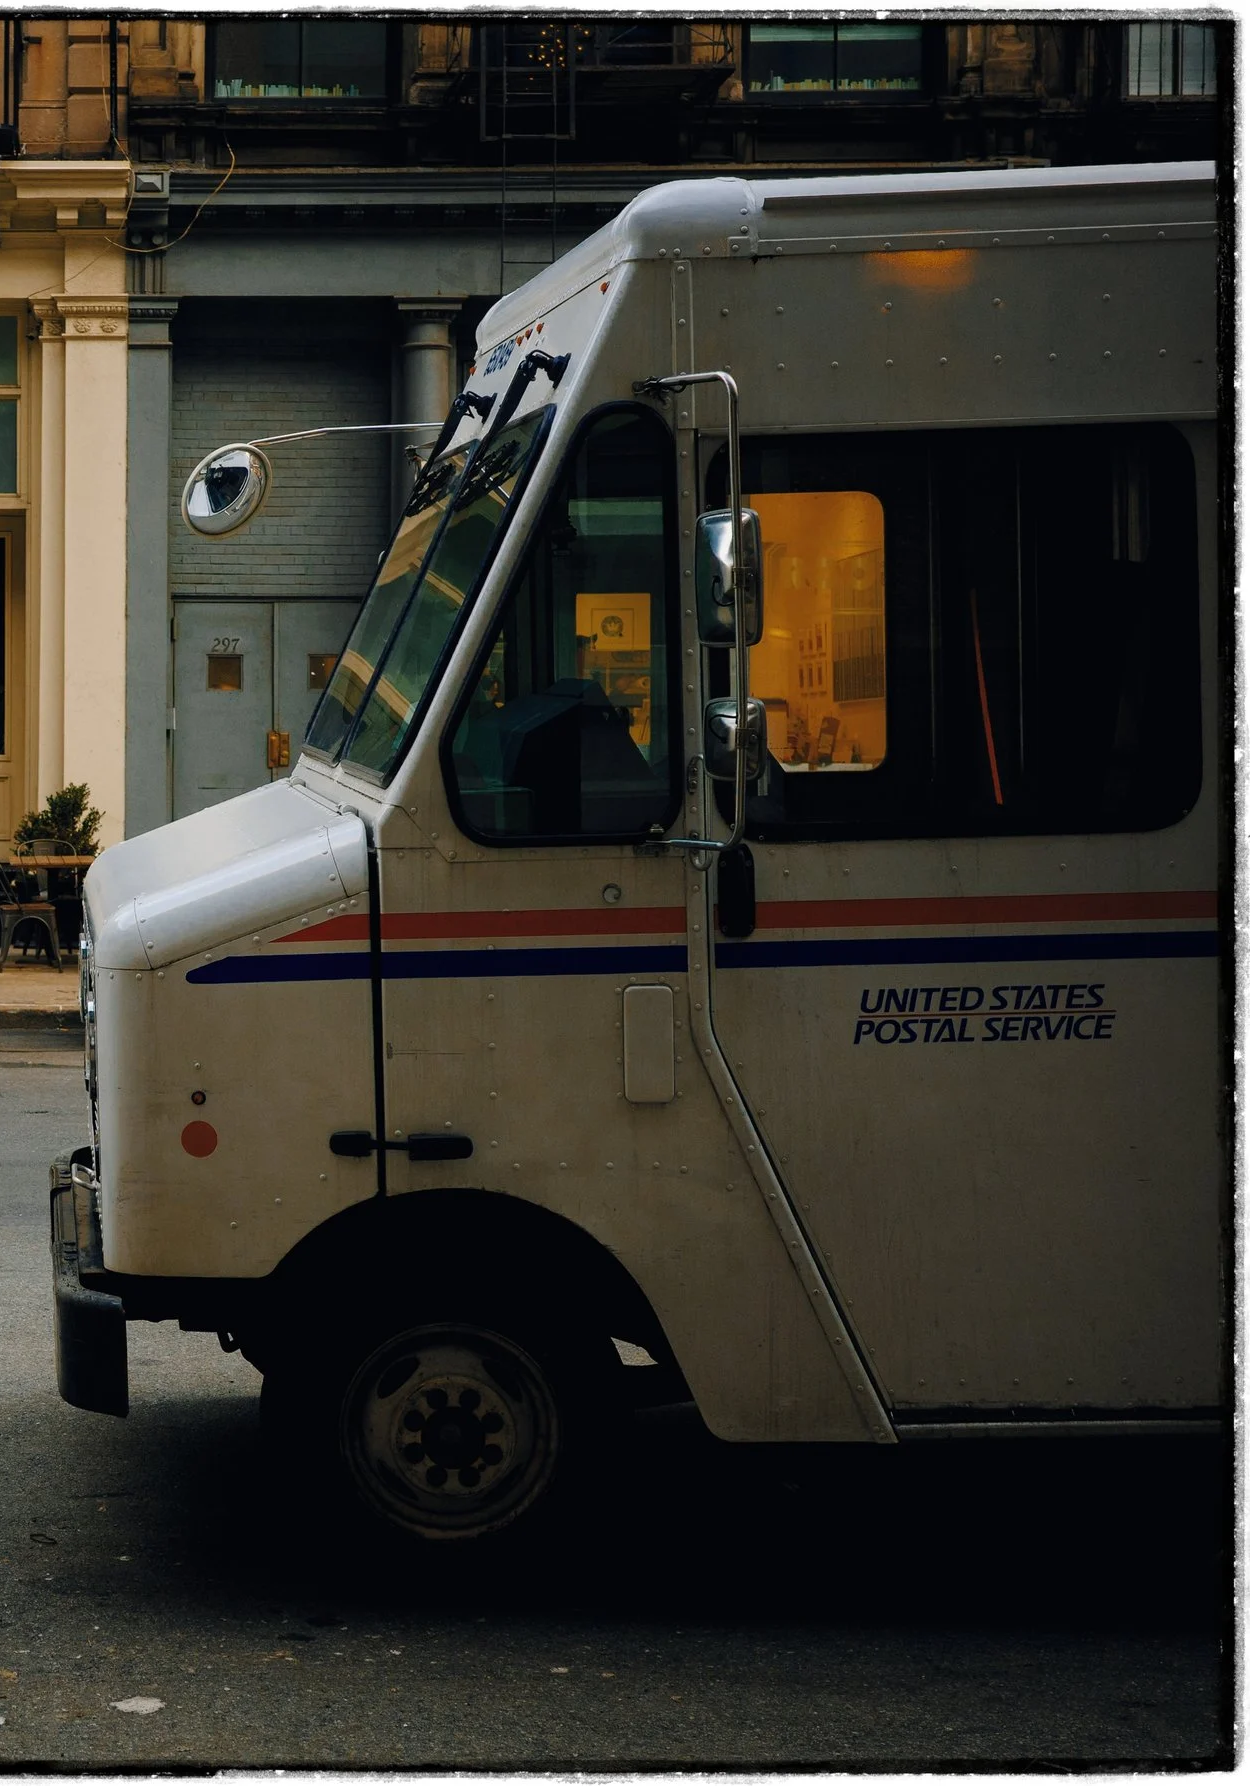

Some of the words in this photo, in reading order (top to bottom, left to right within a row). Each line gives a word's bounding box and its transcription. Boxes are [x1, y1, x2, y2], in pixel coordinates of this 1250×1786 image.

[211, 637, 240, 653] 297
[860, 986, 985, 1013] UNITED
[989, 983, 1106, 1011] STATES
[853, 1017, 975, 1045] POSTAL
[981, 1014, 1116, 1042] SERVICE
